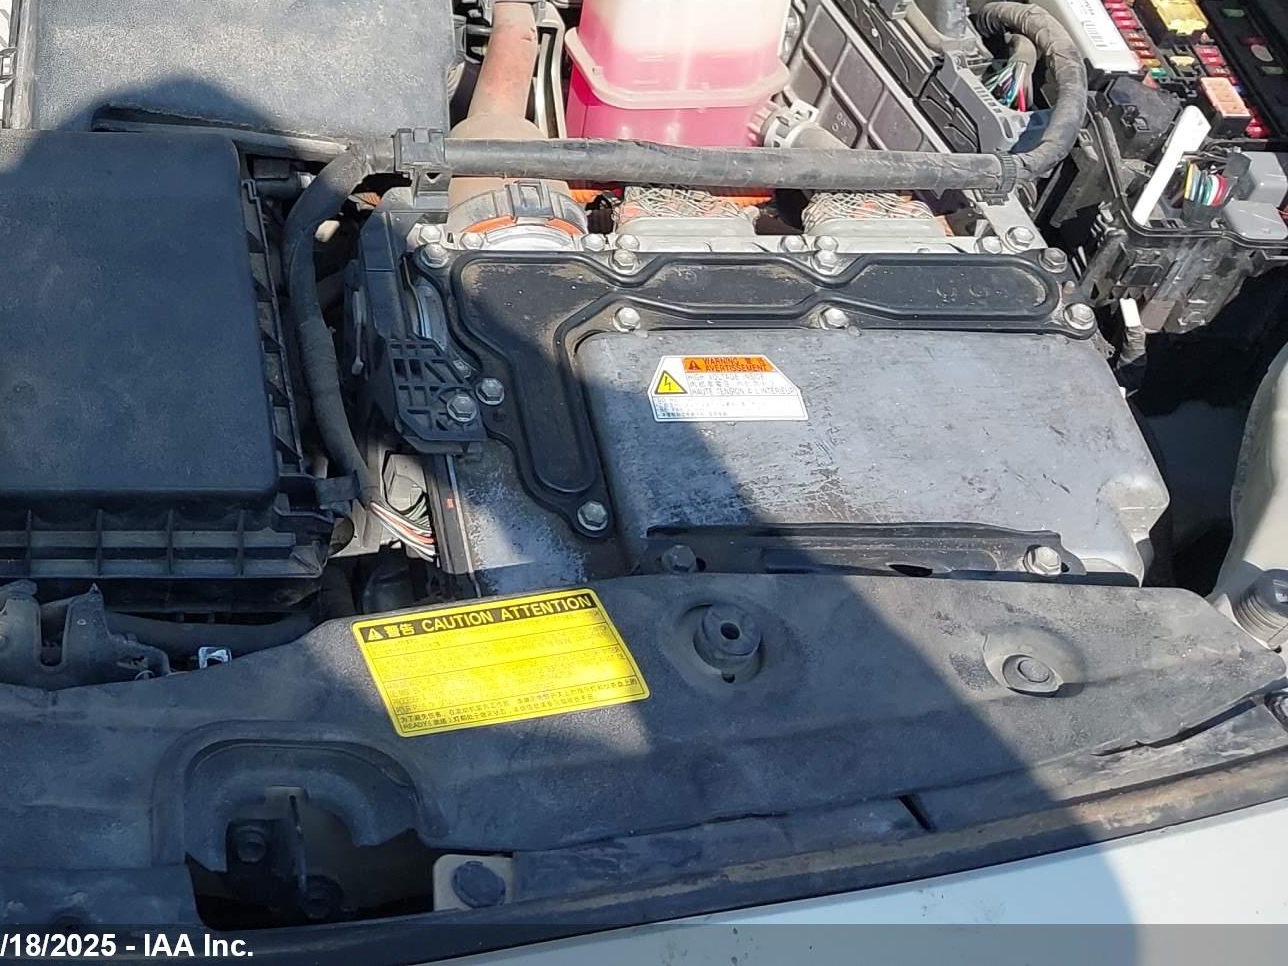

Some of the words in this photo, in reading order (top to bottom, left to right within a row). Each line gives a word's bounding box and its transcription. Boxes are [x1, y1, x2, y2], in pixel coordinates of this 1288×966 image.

[703, 357, 740, 365] WARNING
[705, 364, 768, 372] AVERTISSEMENT
[385, 622, 415, 638] 警告
[422, 610, 494, 632] CAUTION
[501, 595, 592, 621] ATTENTION
